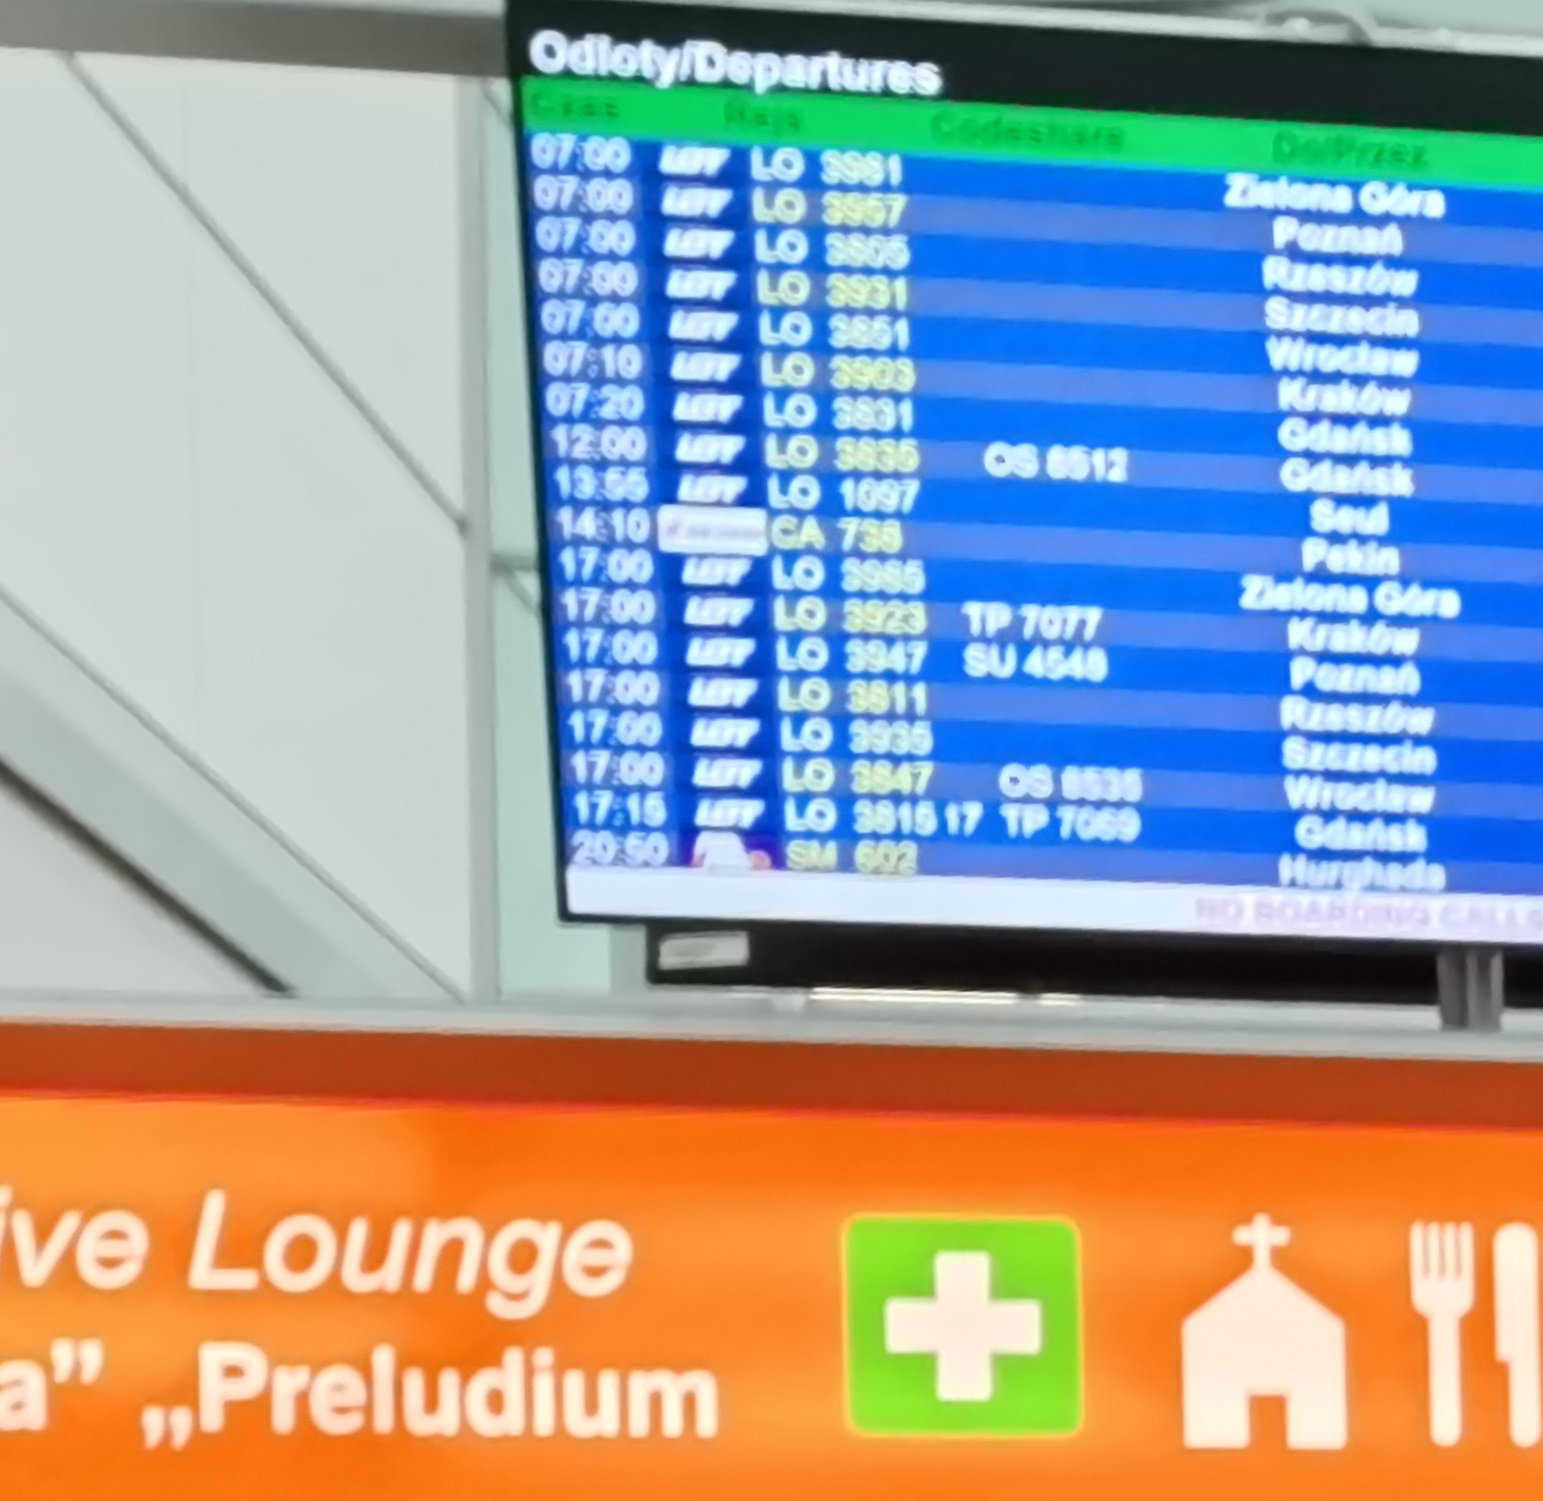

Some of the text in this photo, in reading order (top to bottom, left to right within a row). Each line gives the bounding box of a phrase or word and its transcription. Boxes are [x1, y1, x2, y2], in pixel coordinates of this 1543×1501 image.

[930, 109, 1126, 152] Codeshare
[530, 132, 631, 173] 07:00
[749, 146, 805, 183] LO
[1223, 171, 1354, 214] Zielona
[1357, 180, 1446, 219] Góra
[532, 173, 634, 215] 07:00
[751, 186, 808, 225] LO
[1271, 214, 1404, 256] Poznań
[534, 215, 636, 256] 07:00
[754, 226, 809, 265] LO
[1261, 253, 1419, 297] Rzeszów
[537, 256, 638, 297] 07:00
[755, 268, 811, 306] LO
[1263, 295, 1420, 337] Szczecin
[540, 297, 640, 338] 07:00
[758, 309, 813, 347] LO
[1264, 334, 1420, 378] Wrocław
[542, 339, 643, 380] 07:10
[760, 350, 816, 388] LO
[1276, 376, 1412, 416] Kraków
[544, 380, 645, 421] 07:20
[762, 391, 817, 429] LO
[1277, 415, 1413, 457] Gdańsk
[551, 423, 648, 461] 12:00
[763, 432, 820, 469] LO
[982, 441, 1040, 479] OS
[1278, 456, 1416, 497] Gdańsk
[554, 463, 649, 503] 13:55
[766, 473, 821, 510] LO
[1308, 496, 1390, 536] Seul
[556, 507, 650, 546] 14:10
[1300, 536, 1401, 576] Pekin
[559, 544, 654, 584] 17:00
[771, 553, 825, 591] LO
[1238, 572, 1369, 614] Zielona
[1372, 579, 1461, 619] Góra
[560, 586, 657, 625] 17:00
[772, 594, 828, 632] LO
[961, 601, 1013, 637] TP
[1020, 603, 1102, 641] 7077
[1286, 616, 1421, 656] Kraków
[563, 625, 658, 665] 17:00
[775, 634, 829, 672] LO
[844, 637, 928, 674] 3947
[963, 641, 1017, 678] SU
[1289, 654, 1421, 695] Poznań
[565, 667, 661, 706] 17:00
[776, 675, 833, 713] LO
[845, 678, 927, 715] 3811
[1278, 694, 1436, 735] Rzeszów
[568, 707, 663, 747] 17:00
[779, 715, 833, 752] LO
[1281, 734, 1437, 775] Szczecin
[570, 749, 665, 787] 17:00
[781, 756, 837, 793] LO
[1282, 774, 1436, 814] Wrocław
[574, 788, 667, 827] 17:15
[783, 795, 838, 833] LO
[999, 801, 1050, 837] TP
[1294, 813, 1428, 852] Gdańsk
[187, 1189, 633, 1321] Lounge
[141, 1341, 719, 1452] „Preludium
